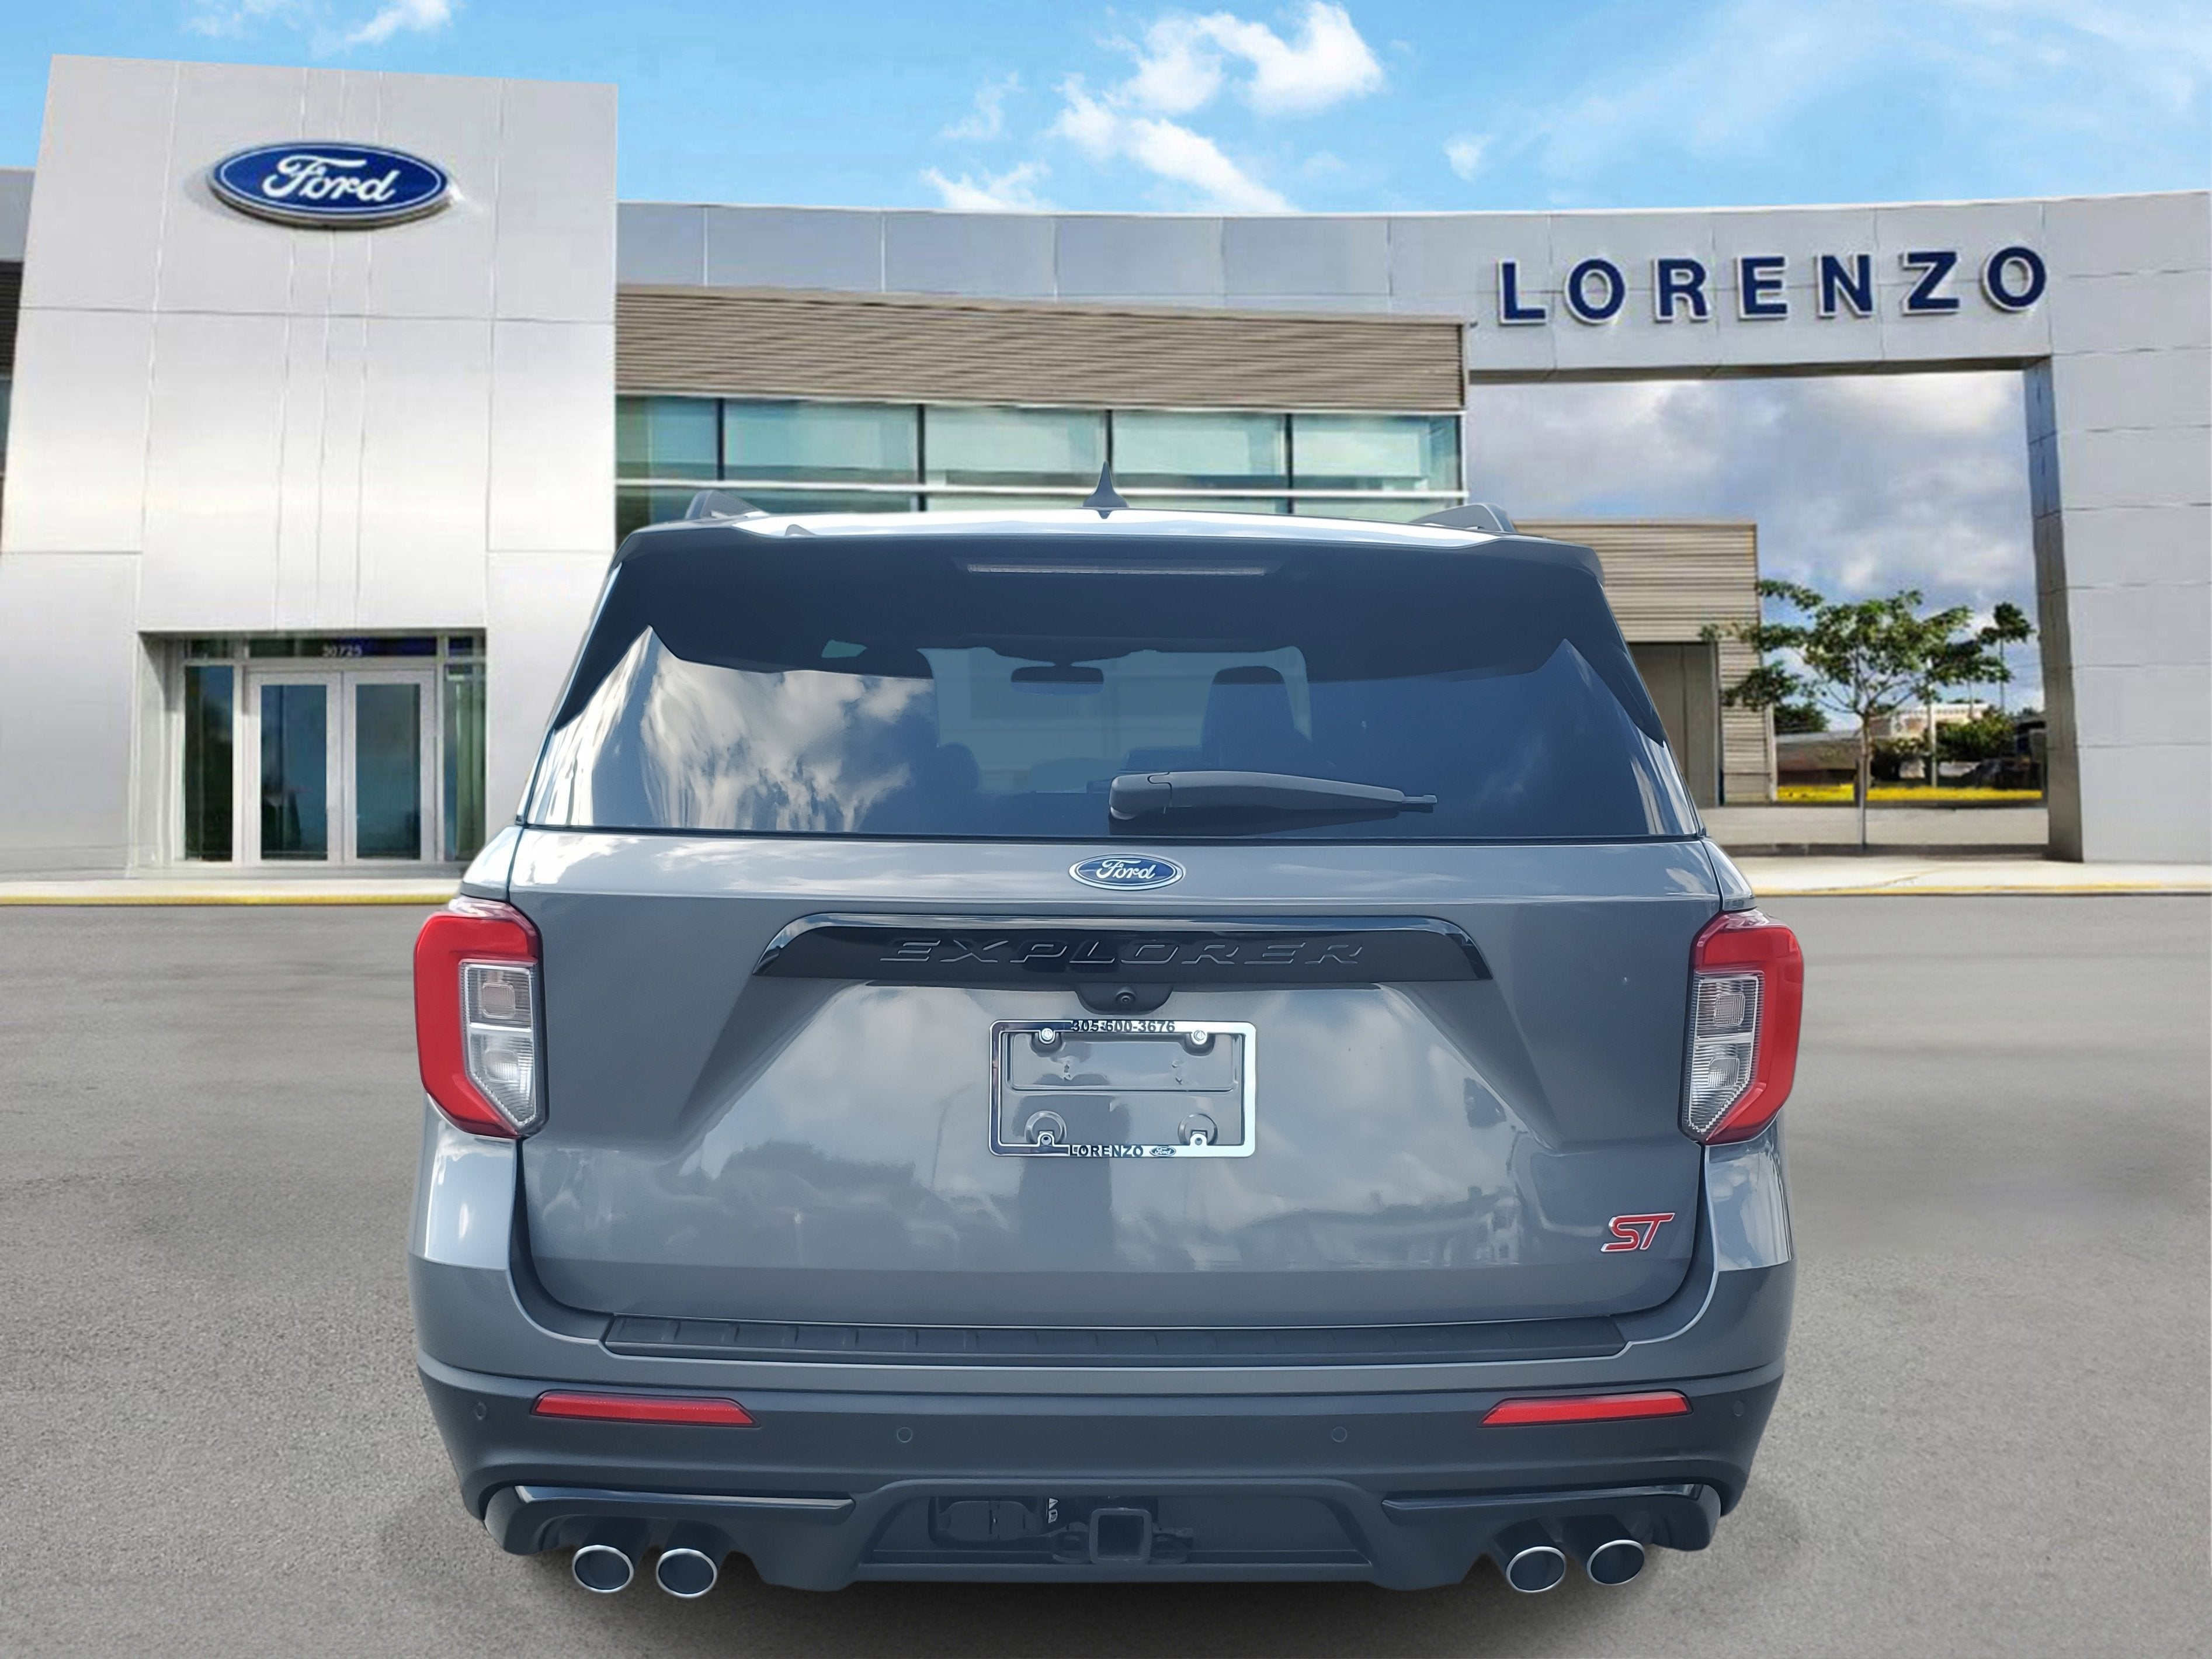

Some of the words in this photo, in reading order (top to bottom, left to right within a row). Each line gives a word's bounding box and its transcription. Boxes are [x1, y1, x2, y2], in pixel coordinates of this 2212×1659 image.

[262, 154, 401, 202] Ford
[1498, 245, 2047, 325] LORENZO
[1096, 859, 1157, 879] Ford
[880, 939, 1363, 964] EXPLORER
[1071, 1021, 1175, 1032] 305-600-3676
[1069, 1145, 1144, 1157] LORENZO
[1154, 1147, 1172, 1155] Ford
[1600, 1213, 1675, 1252] ST
